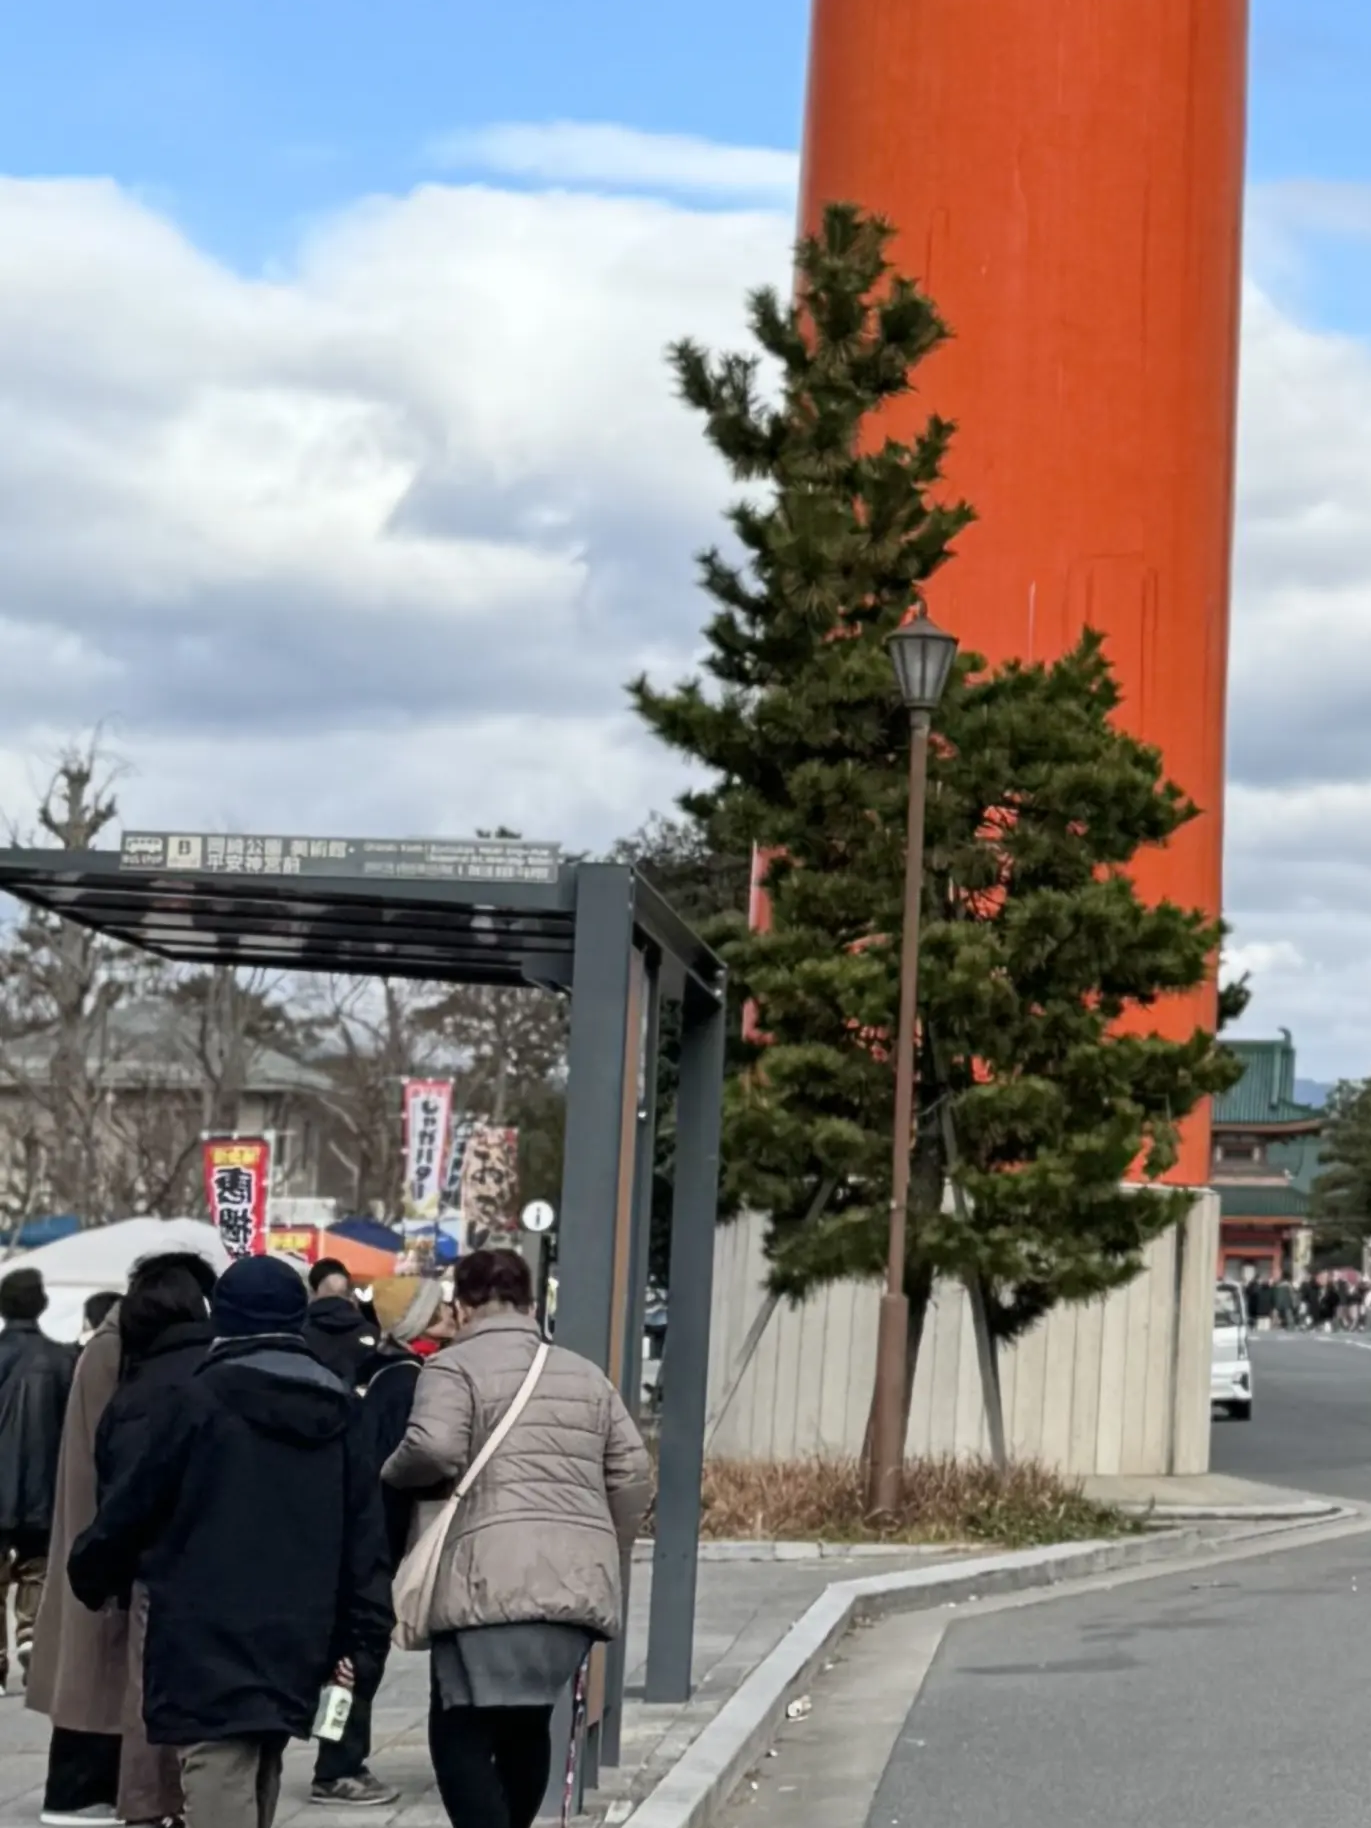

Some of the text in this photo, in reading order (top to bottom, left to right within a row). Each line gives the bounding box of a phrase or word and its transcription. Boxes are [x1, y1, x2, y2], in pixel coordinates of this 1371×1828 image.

[415, 1098, 439, 1200] じゃがバター
